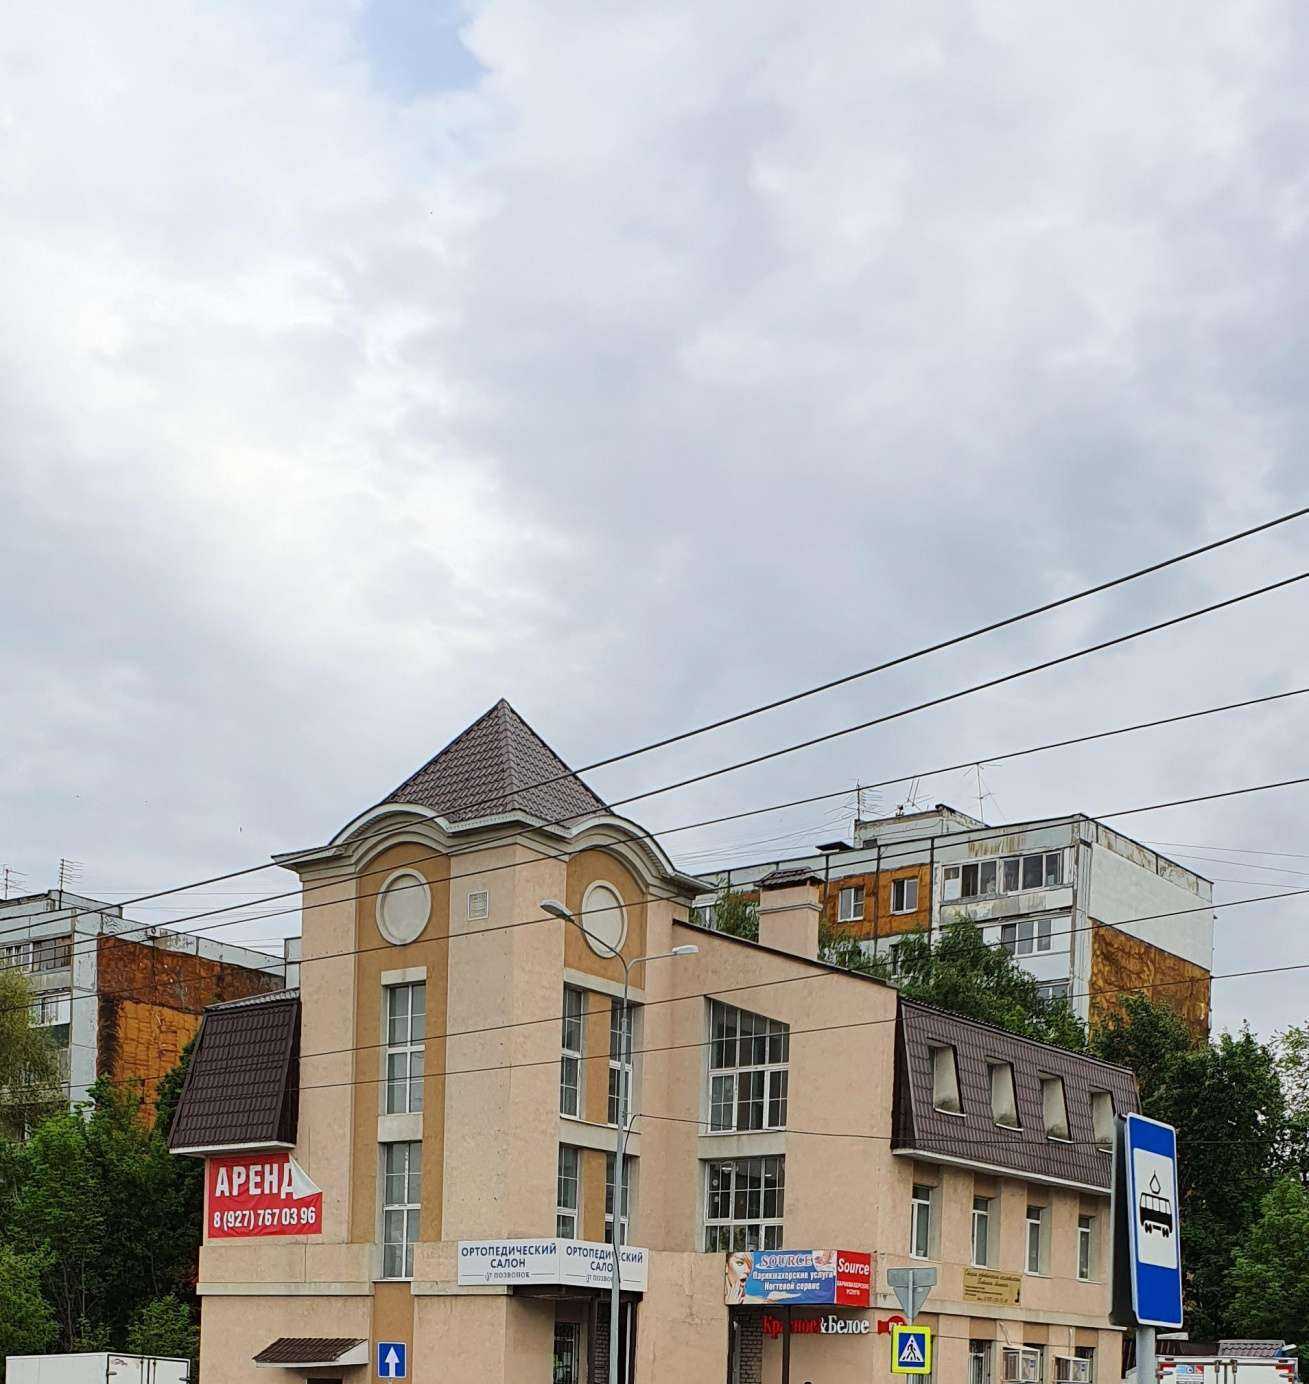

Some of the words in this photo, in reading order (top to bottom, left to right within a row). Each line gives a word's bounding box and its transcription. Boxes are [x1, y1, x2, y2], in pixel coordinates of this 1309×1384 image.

[215, 1163, 298, 1200] АРЕНД
[213, 1211, 221, 1228] 8
[223, 1209, 255, 1231] (927)
[257, 1208, 279, 1226] 767
[282, 1207, 298, 1225] 03
[300, 1206, 316, 1224] 96
[461, 1243, 557, 1257] ОРТОПЕДИЧЕСКИЙ
[566, 1245, 643, 1264] ОРТОПЕДИСКИЙ
[490, 1258, 526, 1268] САЛОН
[590, 1261, 614, 1272] САЛО
[838, 1258, 870, 1276] Source
